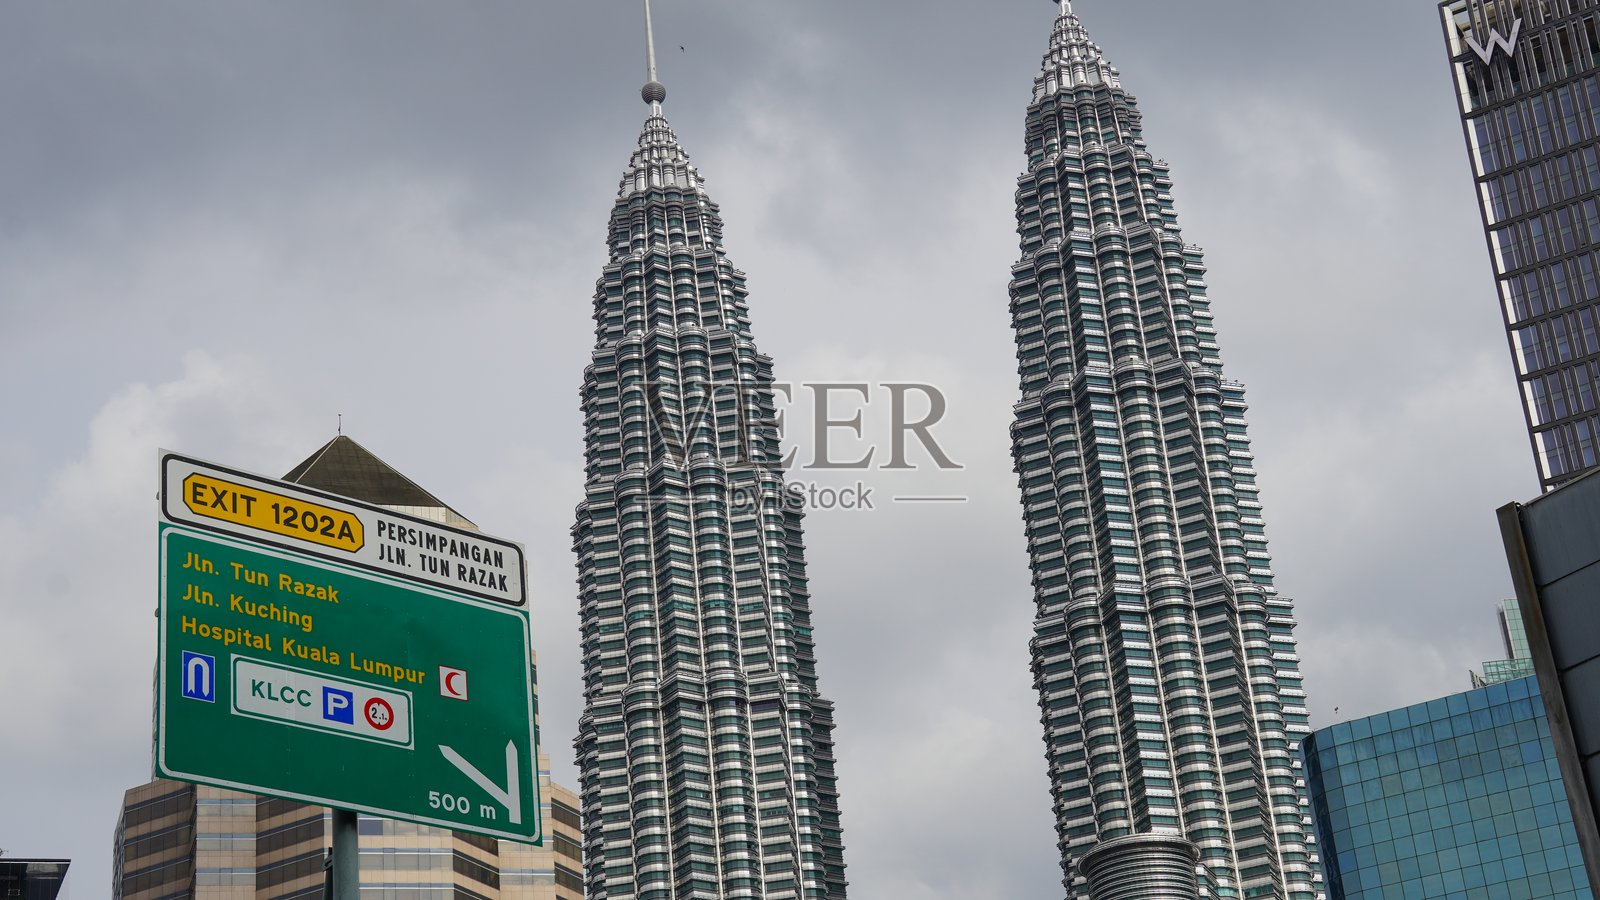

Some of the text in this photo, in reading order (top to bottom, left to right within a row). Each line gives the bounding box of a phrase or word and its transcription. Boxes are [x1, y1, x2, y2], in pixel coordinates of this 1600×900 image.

[191, 482, 356, 543] EXIT 1202A
[377, 520, 504, 569] PERSIMPANGAN
[378, 544, 508, 593] JLN. TUN RAZAK
[182, 552, 340, 604] Jln. Tun Razak
[182, 583, 313, 633] Jln. Kuching
[181, 615, 426, 684] Hospital Kuala Lumpur
[251, 680, 349, 716] KLCC P
[428, 790, 496, 820] 500 m
